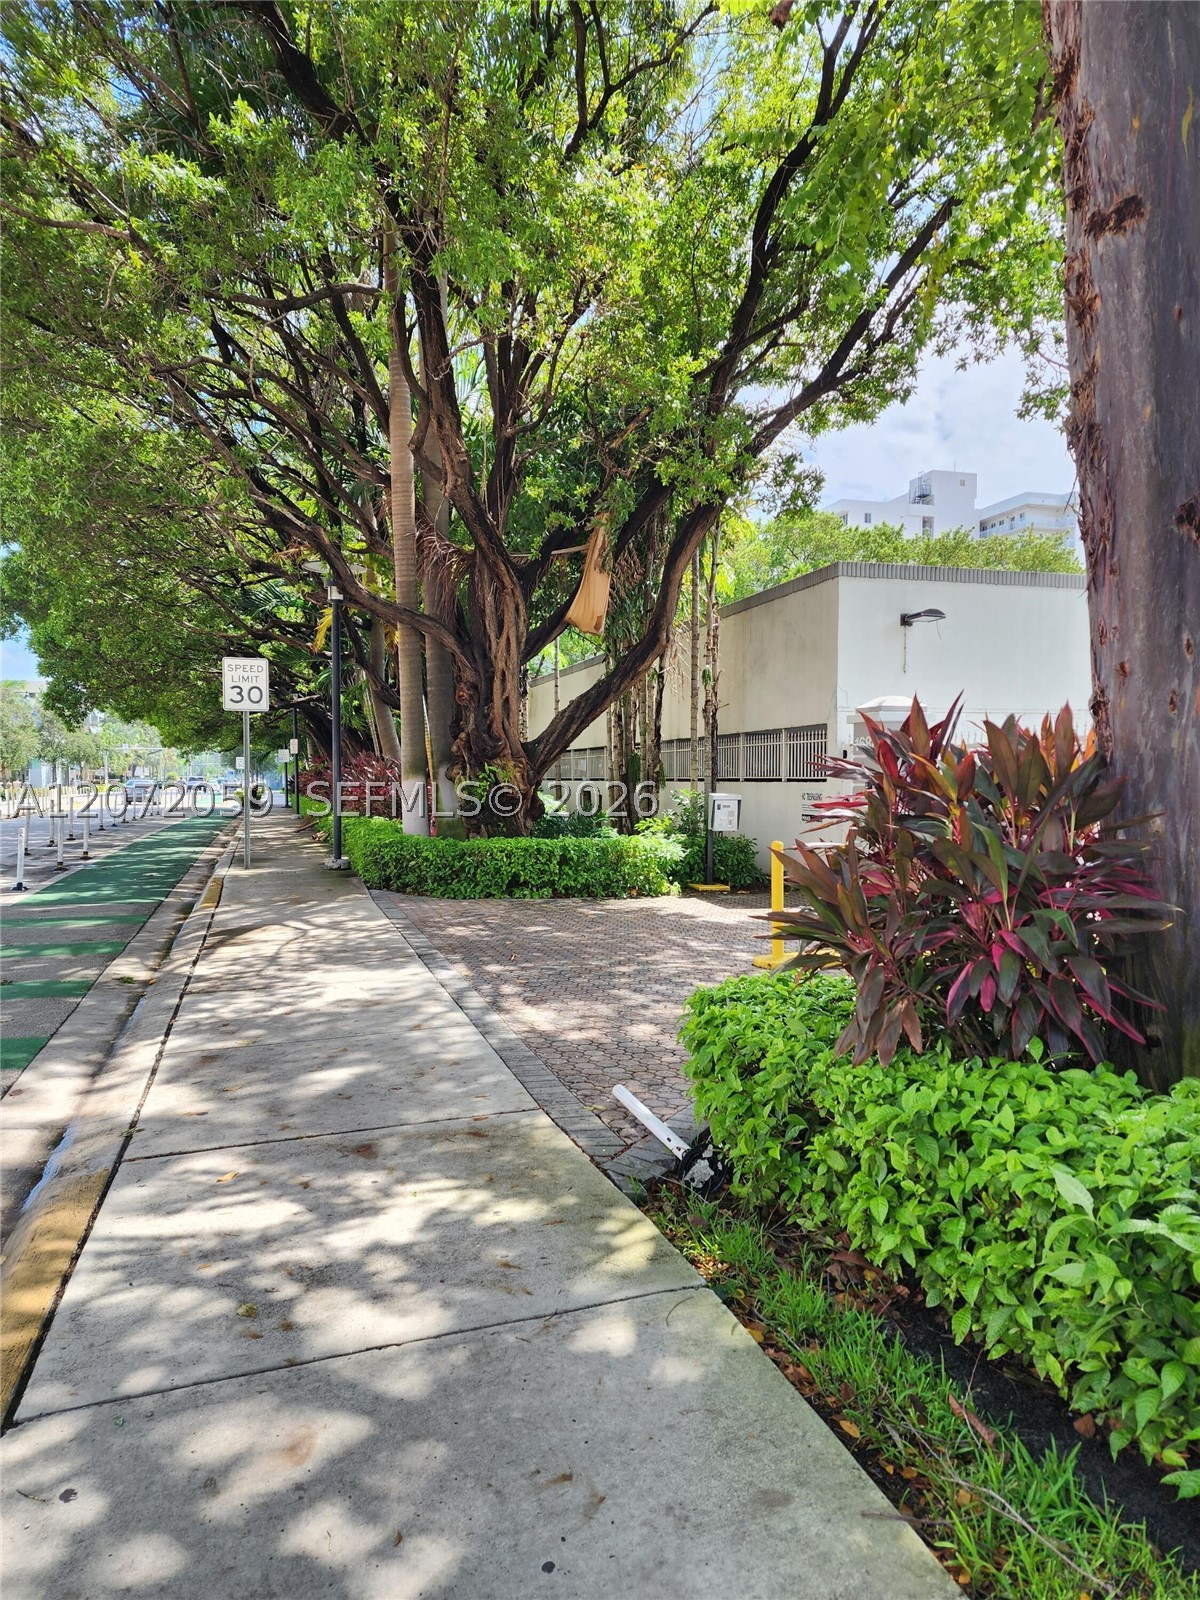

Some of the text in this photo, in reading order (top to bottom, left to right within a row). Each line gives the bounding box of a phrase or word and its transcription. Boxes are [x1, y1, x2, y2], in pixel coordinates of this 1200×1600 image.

[227, 664, 264, 673] SPEED
[231, 675, 260, 684] LIMIT
[229, 685, 263, 704] 30
